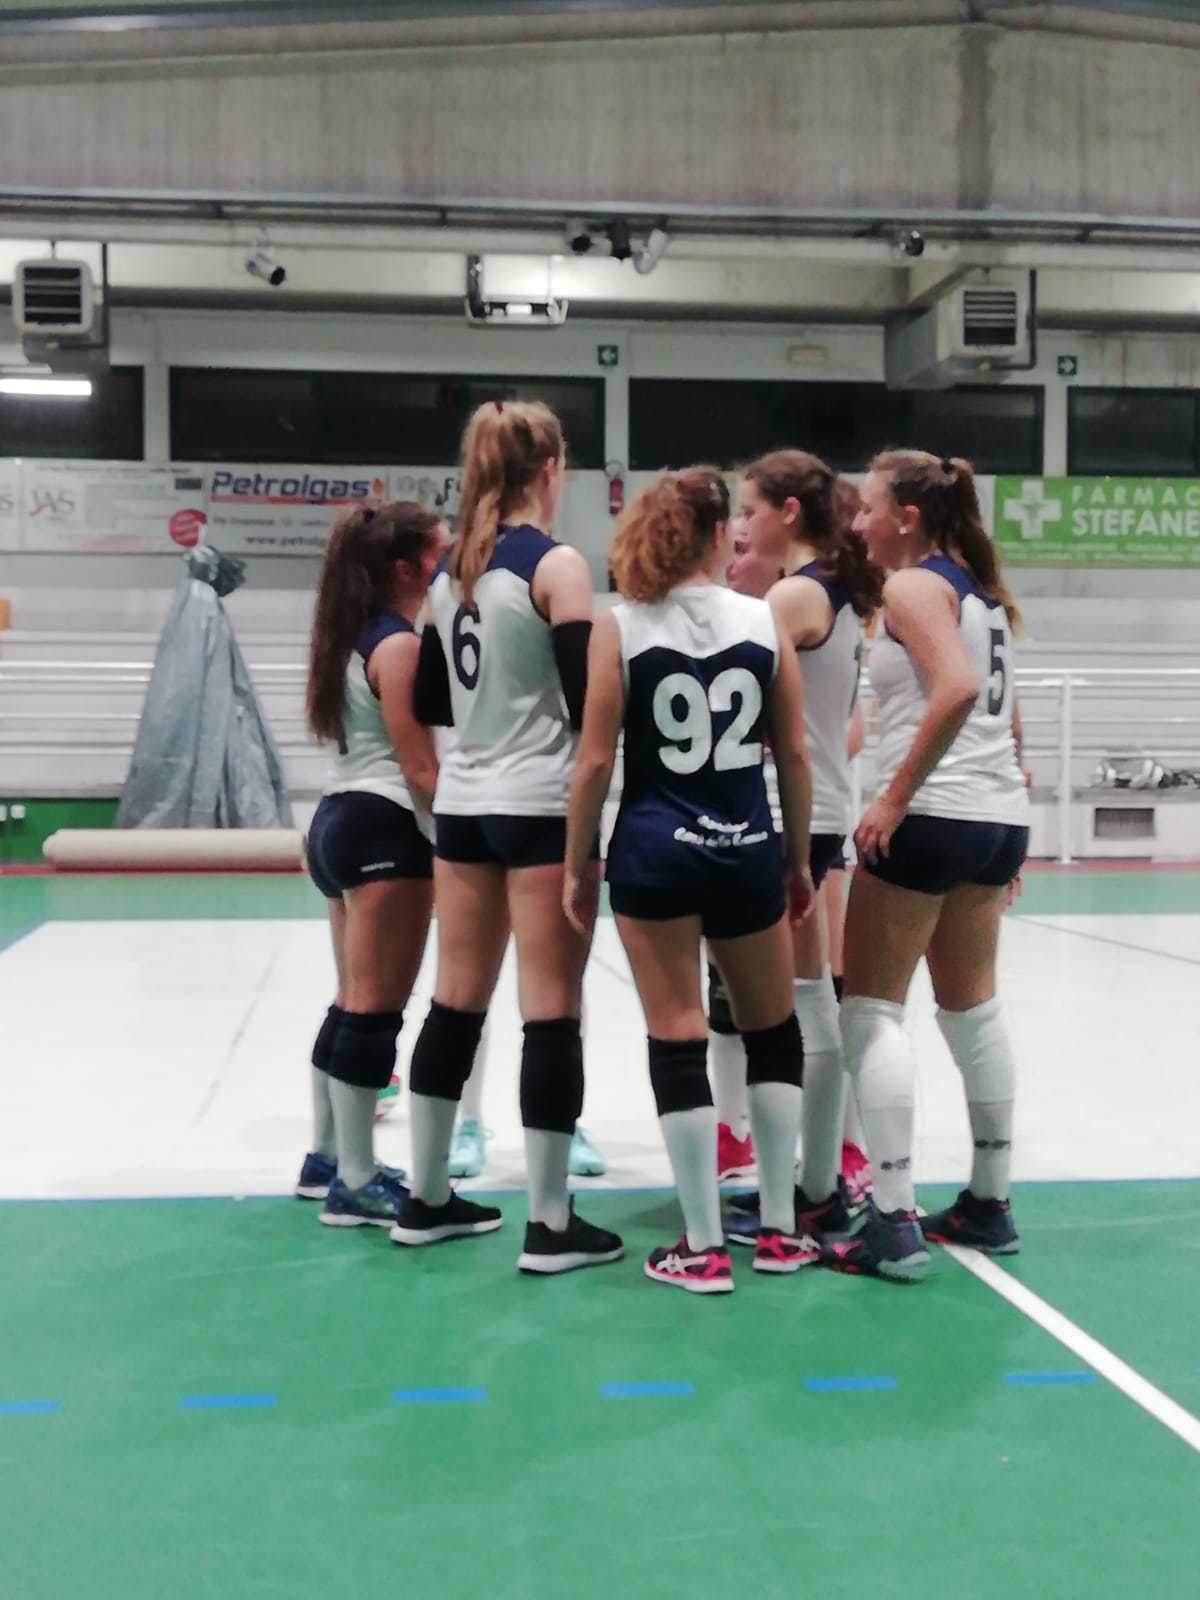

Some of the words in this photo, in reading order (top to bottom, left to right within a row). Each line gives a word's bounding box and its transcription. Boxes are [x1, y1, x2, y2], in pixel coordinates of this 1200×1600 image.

[211, 471, 372, 504] Petrolgas
[452, 602, 481, 690] 6
[987, 628, 1006, 716] 5
[652, 667, 763, 775] 92
